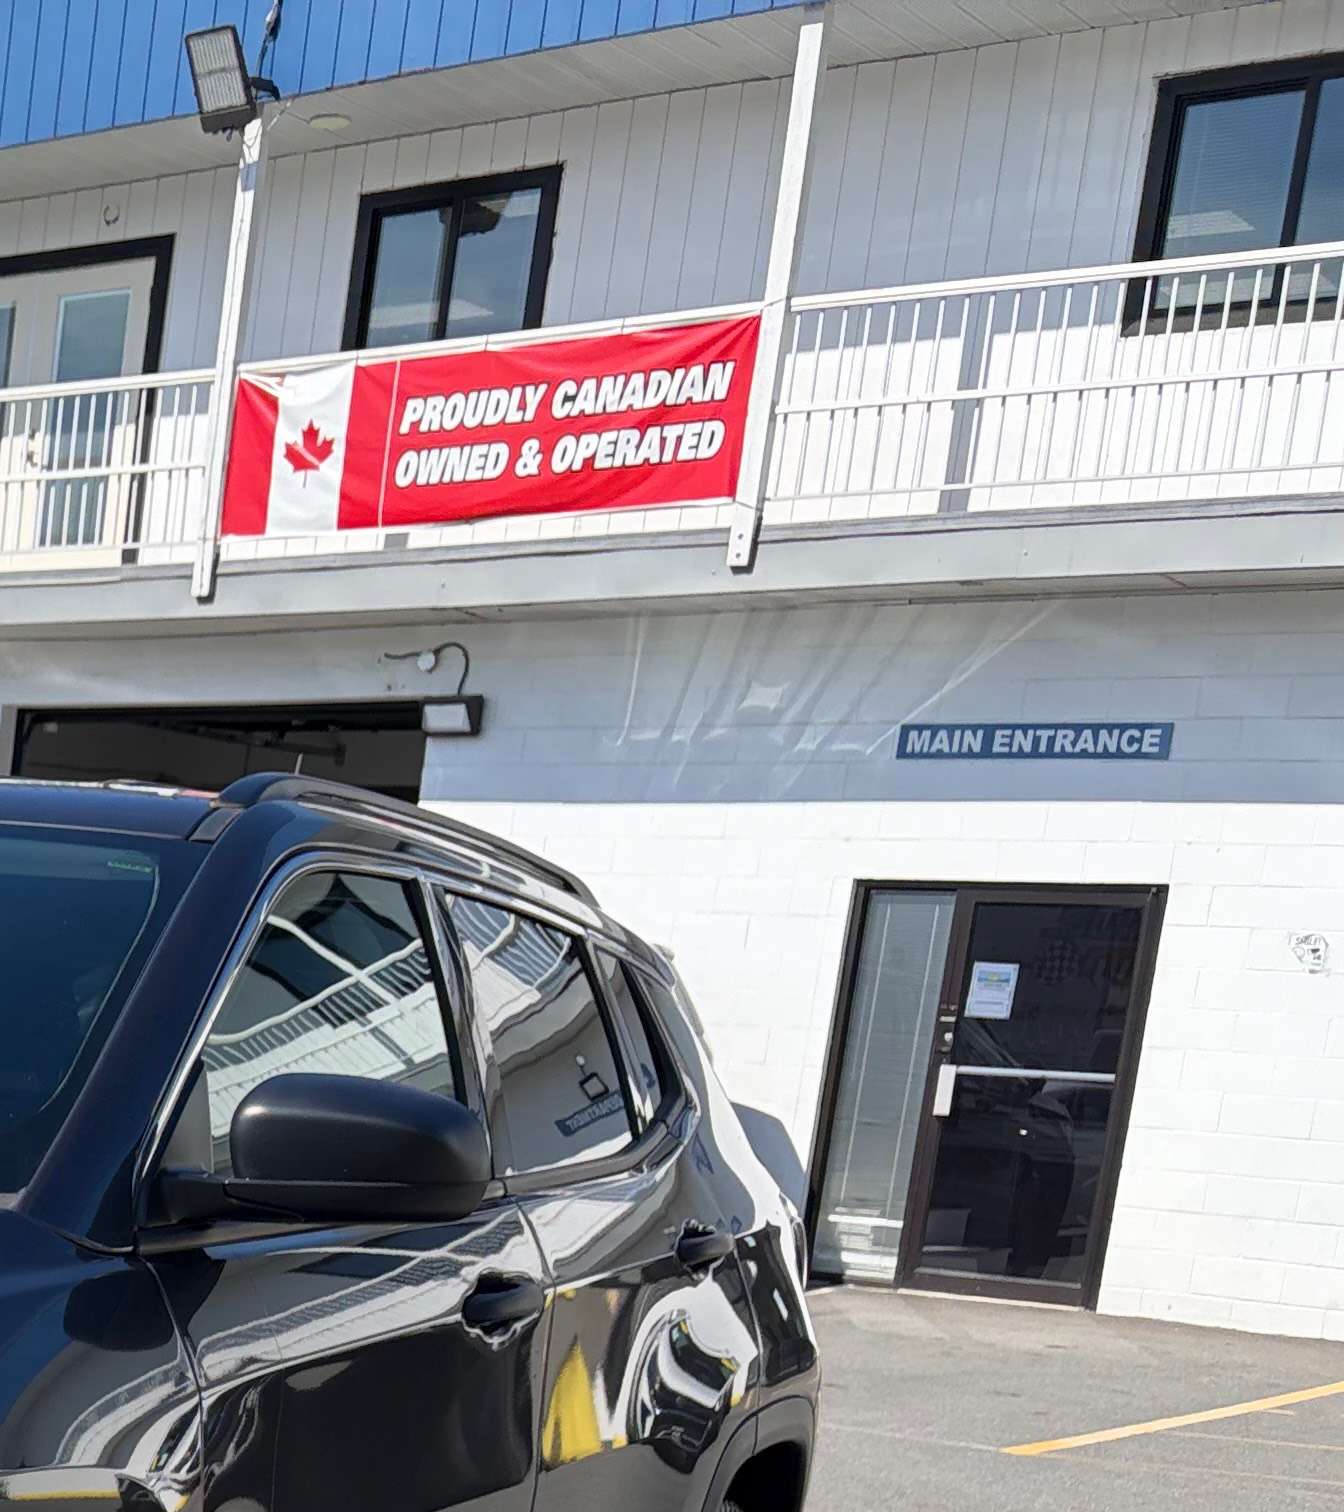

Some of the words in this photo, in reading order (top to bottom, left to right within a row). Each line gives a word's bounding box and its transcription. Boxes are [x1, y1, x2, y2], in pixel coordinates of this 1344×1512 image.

[399, 383, 548, 435] PROUDLY
[551, 361, 736, 419] CANADIAN
[394, 440, 510, 488] OWNED
[513, 437, 544, 478] &
[551, 420, 726, 474] OPERATED
[906, 729, 985, 753] MAIN
[992, 729, 1163, 753] ENTRANCE
